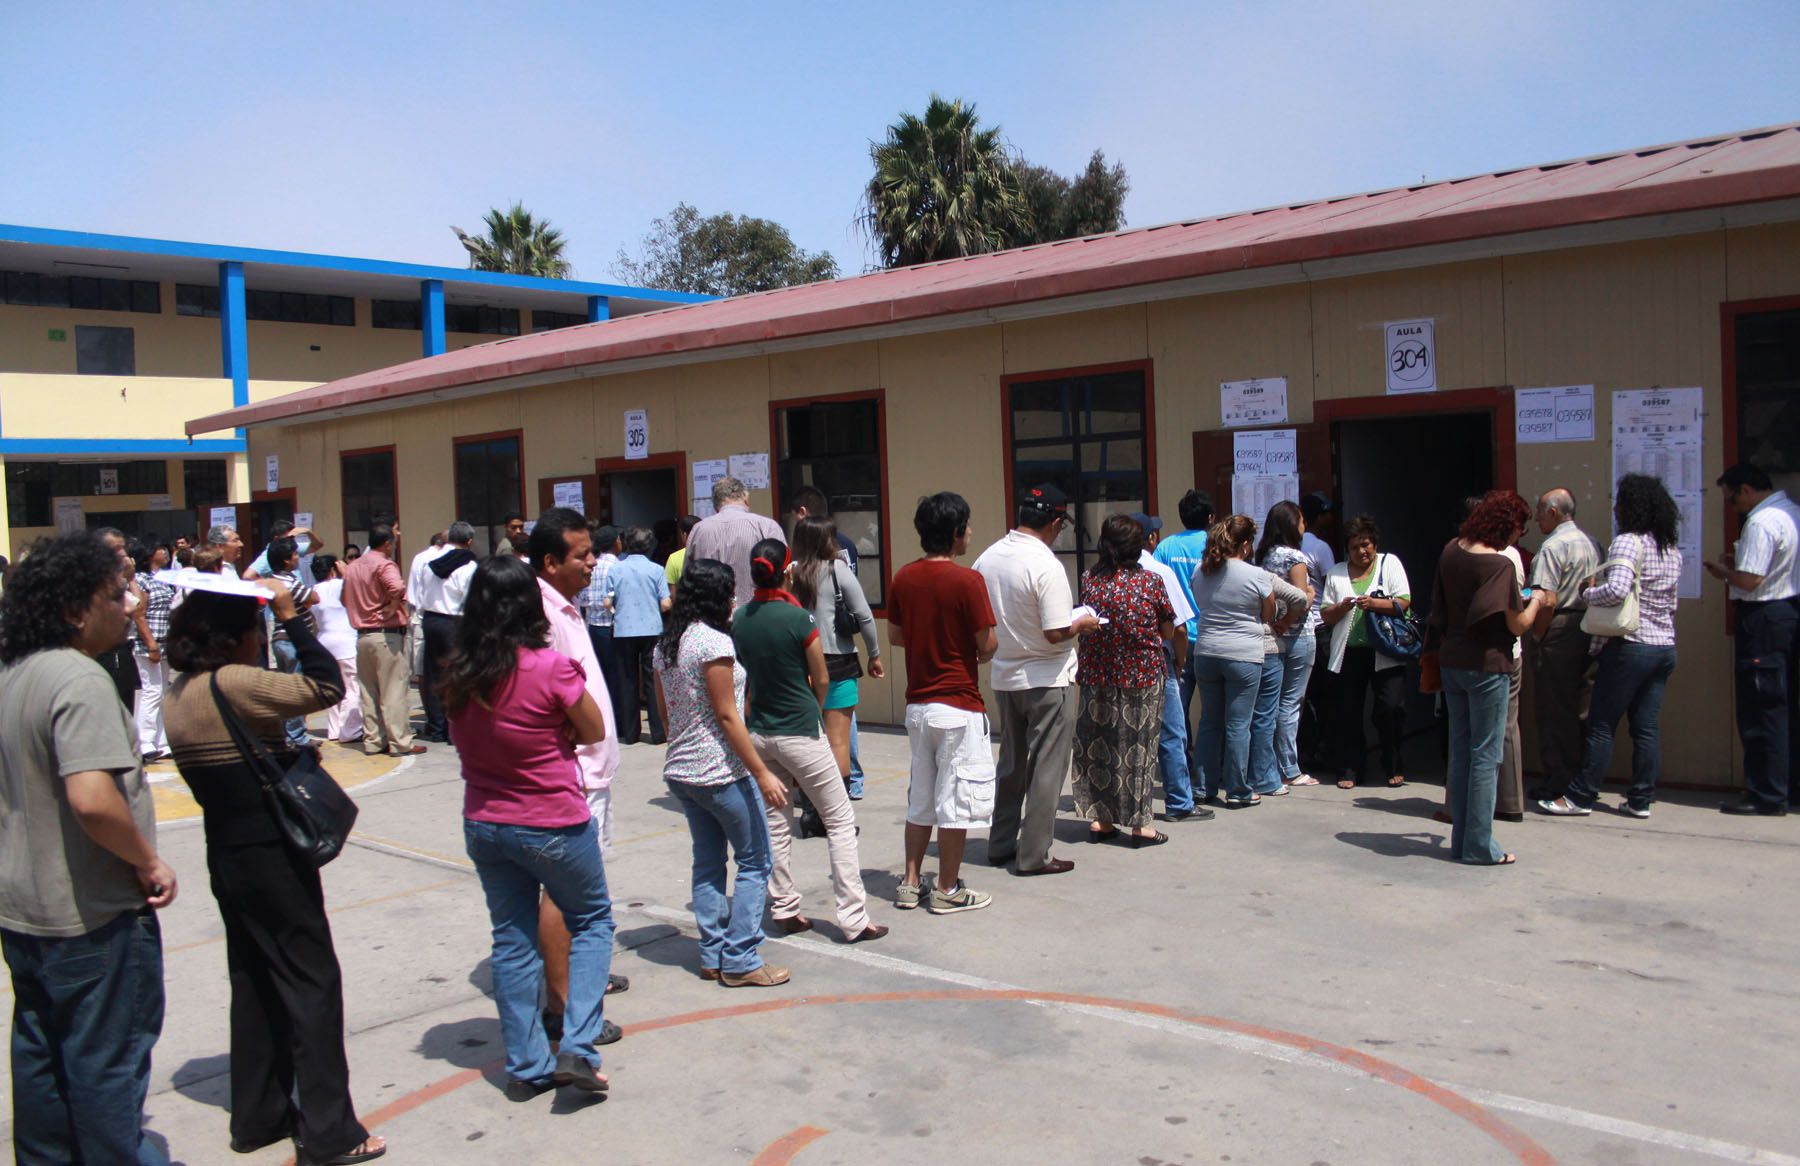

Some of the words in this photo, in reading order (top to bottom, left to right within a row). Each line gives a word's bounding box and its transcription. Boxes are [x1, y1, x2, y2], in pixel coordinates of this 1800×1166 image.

[1396, 327, 1422, 336] AULA
[1391, 345, 1427, 373] 304
[1556, 409, 1592, 423] 039587
[628, 428, 645, 447] 305
